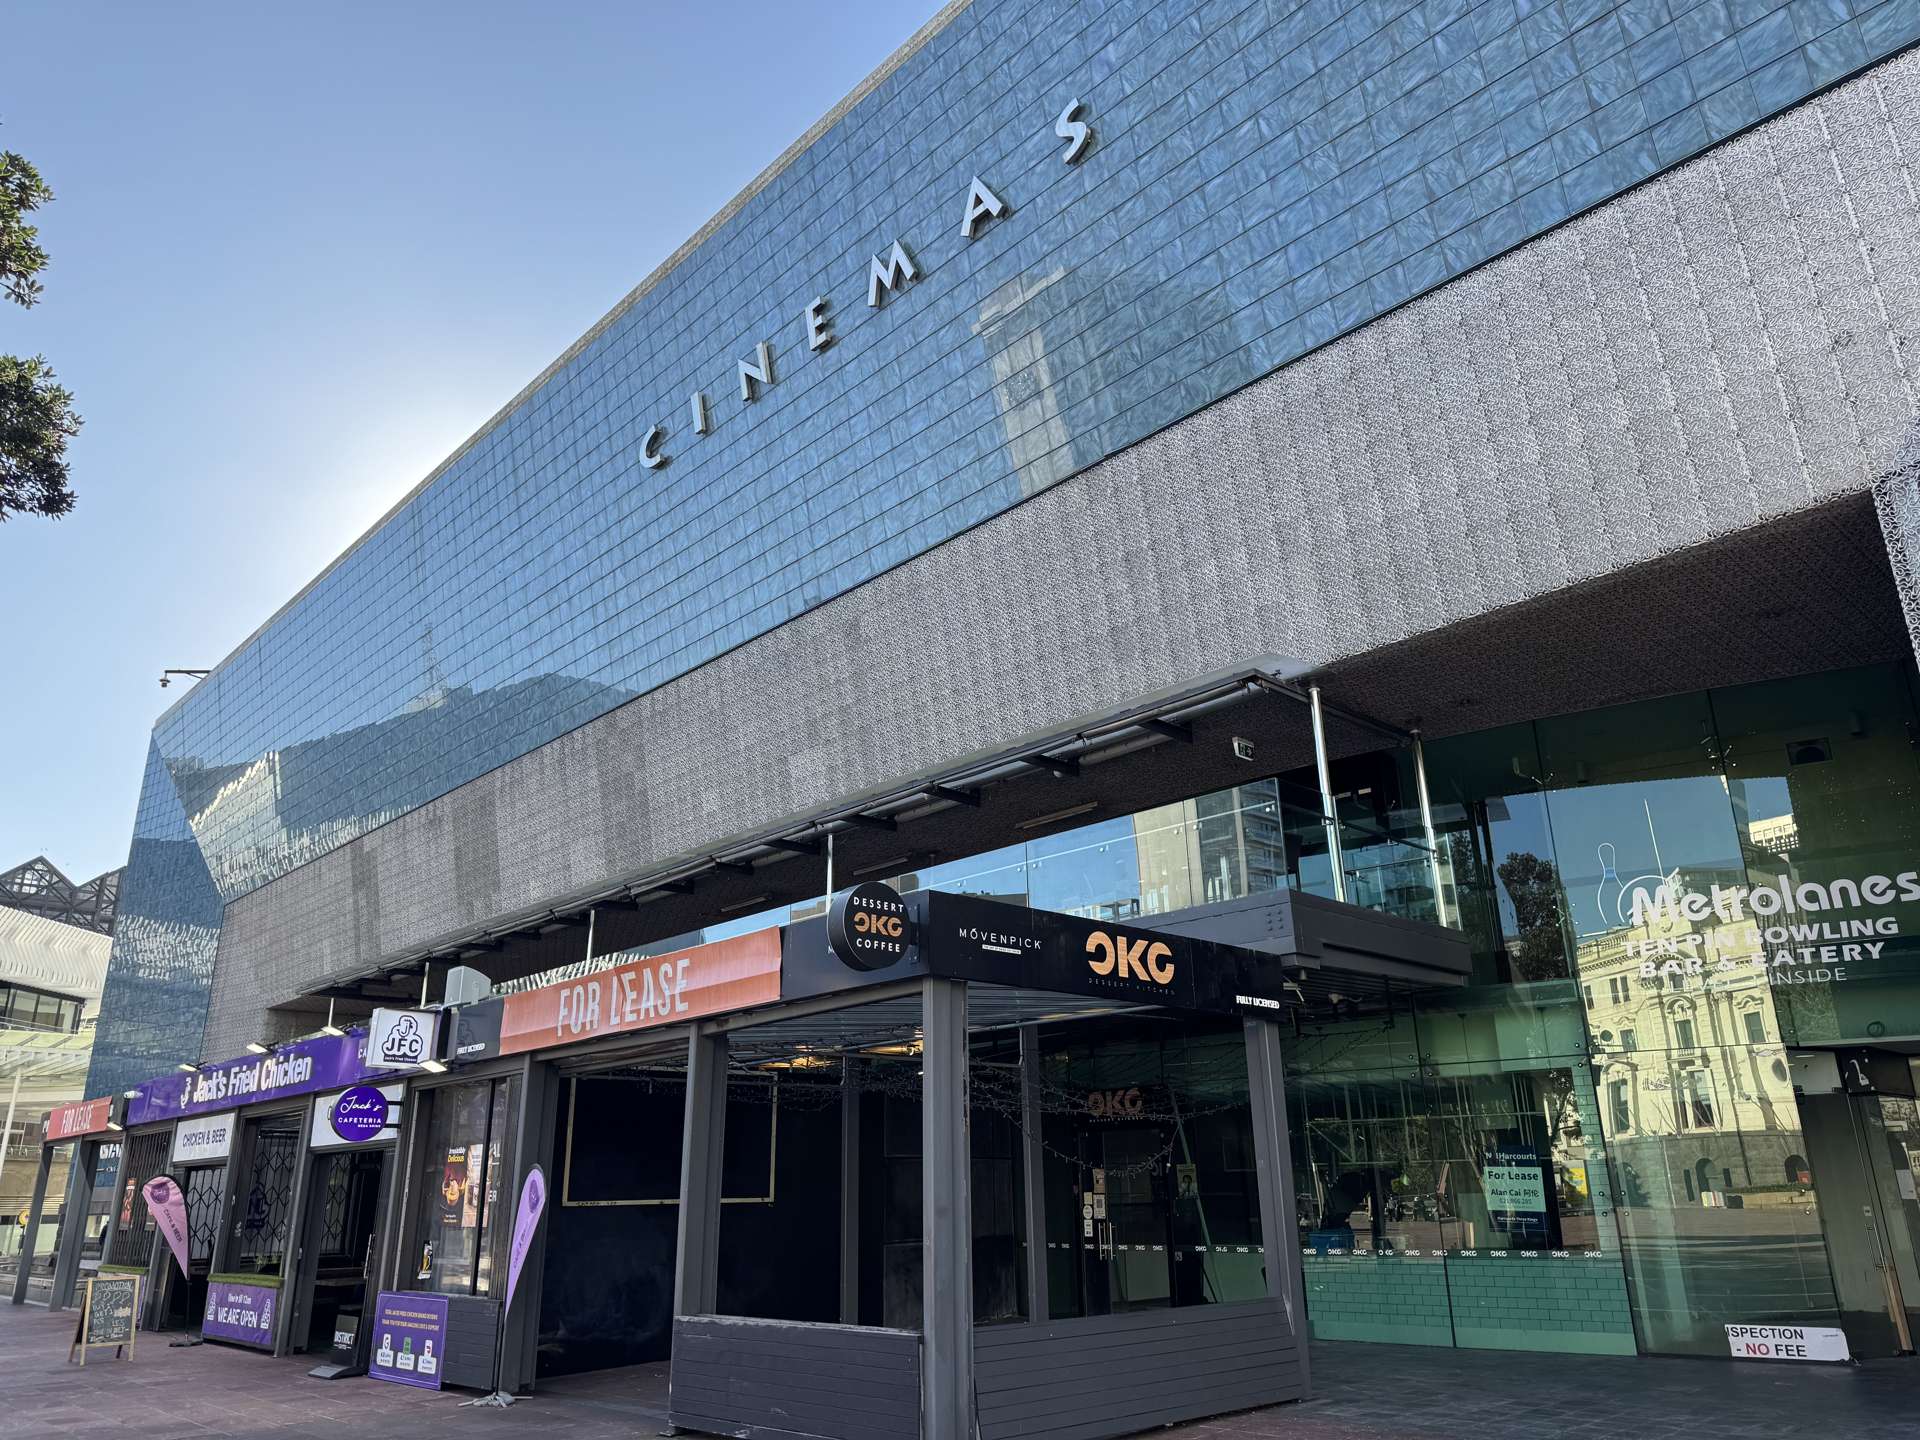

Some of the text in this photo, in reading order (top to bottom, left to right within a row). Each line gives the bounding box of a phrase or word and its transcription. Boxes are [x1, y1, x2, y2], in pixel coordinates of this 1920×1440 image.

[639, 97, 1091, 469] CINEMAS
[853, 896, 904, 913] DESSERT
[1632, 871, 1920, 926] Metrolanes
[856, 938, 900, 953] COFFEE
[1623, 917, 1899, 957] TEN PIN BOWLING
[1640, 942, 1885, 978] BAR & EATERY
[1768, 967, 1848, 985] INSIDE
[557, 958, 690, 1037] FOR LEASE
[385, 1037, 420, 1056] JFC
[193, 1054, 312, 1103] Jack's Fried Chicken
[340, 1095, 383, 1114] Jack's
[61, 1109, 76, 1134] FOR
[74, 1104, 94, 1132] LEASE
[337, 1117, 382, 1125] CAFETERIA
[182, 1128, 227, 1148] CHICKEN & BEER
[447, 1154, 465, 1162] Delicious
[1488, 1171, 1539, 1181] For Lease
[218, 1306, 258, 1328] WE ARE OPEN
[1745, 1343, 1770, 1355] NO
[1775, 1344, 1807, 1357] FEE
